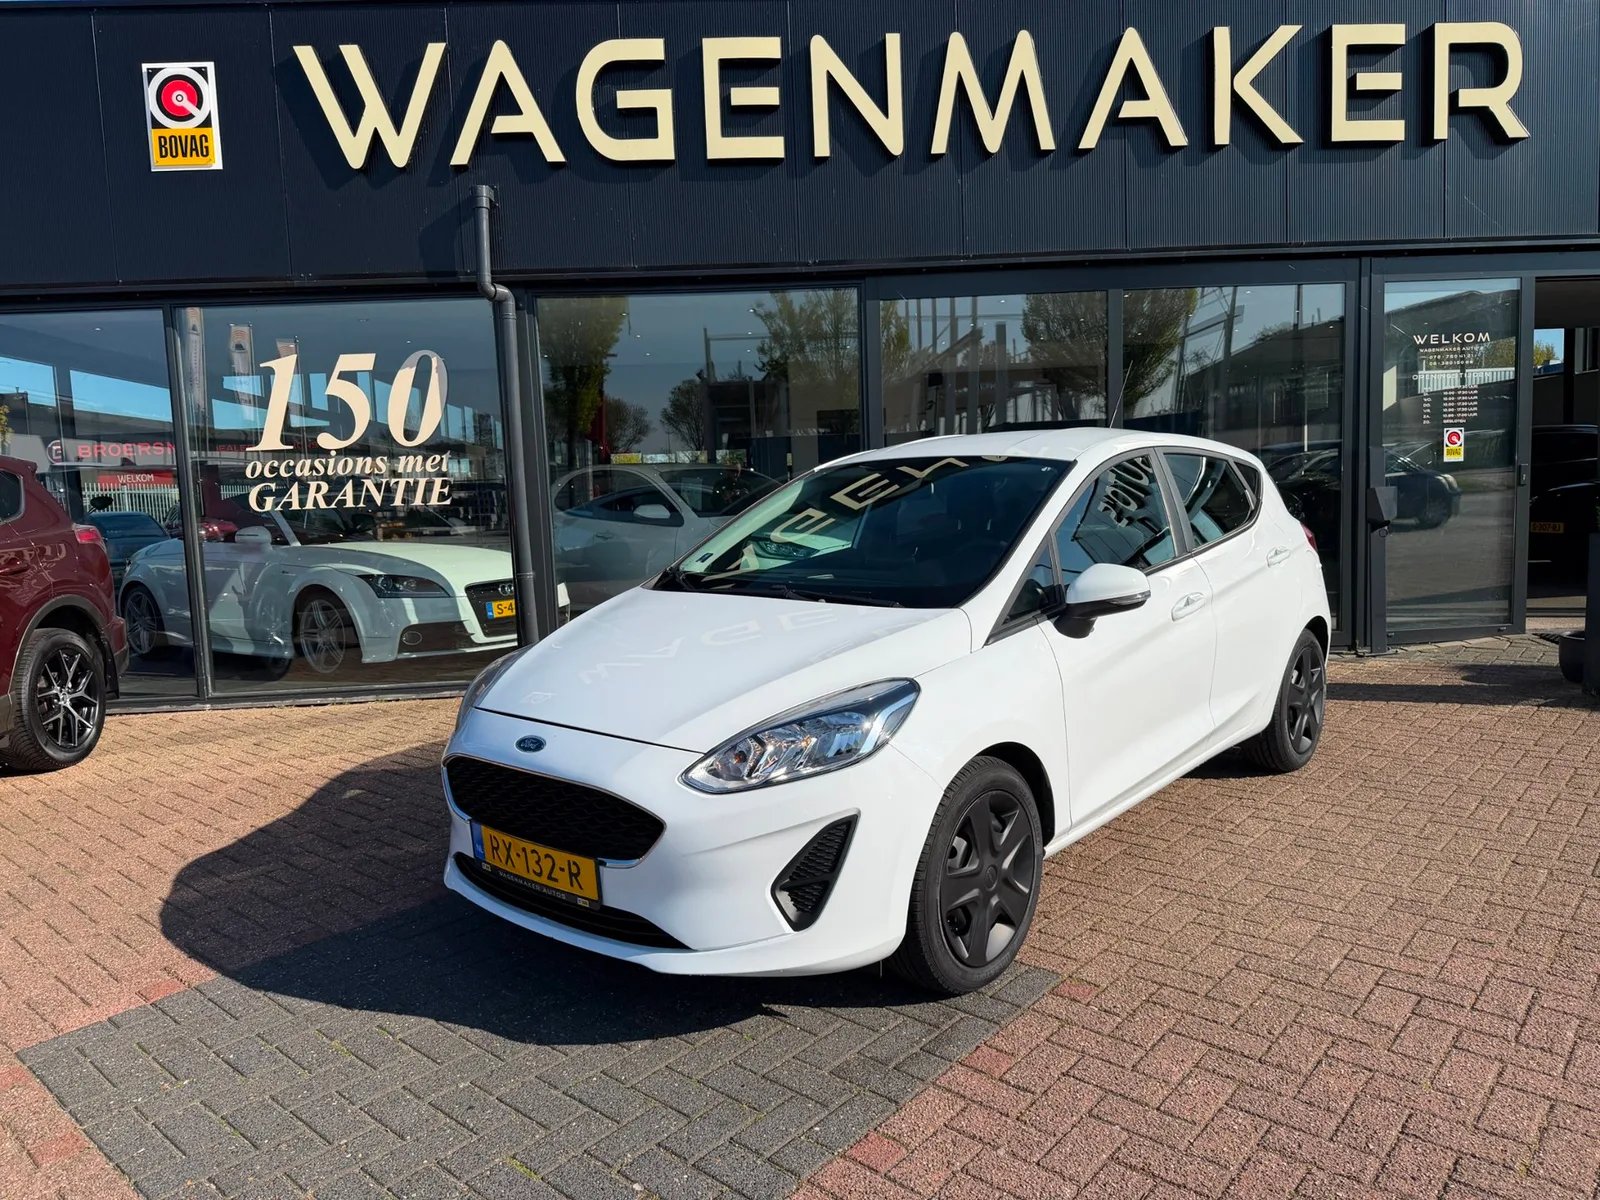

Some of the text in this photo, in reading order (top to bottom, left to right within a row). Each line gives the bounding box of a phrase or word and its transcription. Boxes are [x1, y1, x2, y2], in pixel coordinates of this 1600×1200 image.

[293, 22, 1530, 170] WAGENMAKER
[158, 134, 210, 159] BOVAG
[1413, 332, 1491, 345] WELKOM
[246, 350, 448, 451] 150
[117, 473, 154, 483] WELKOM
[245, 450, 451, 479] occasions met
[248, 477, 454, 513] GARANTIE
[489, 833, 584, 891] RX-132-R
